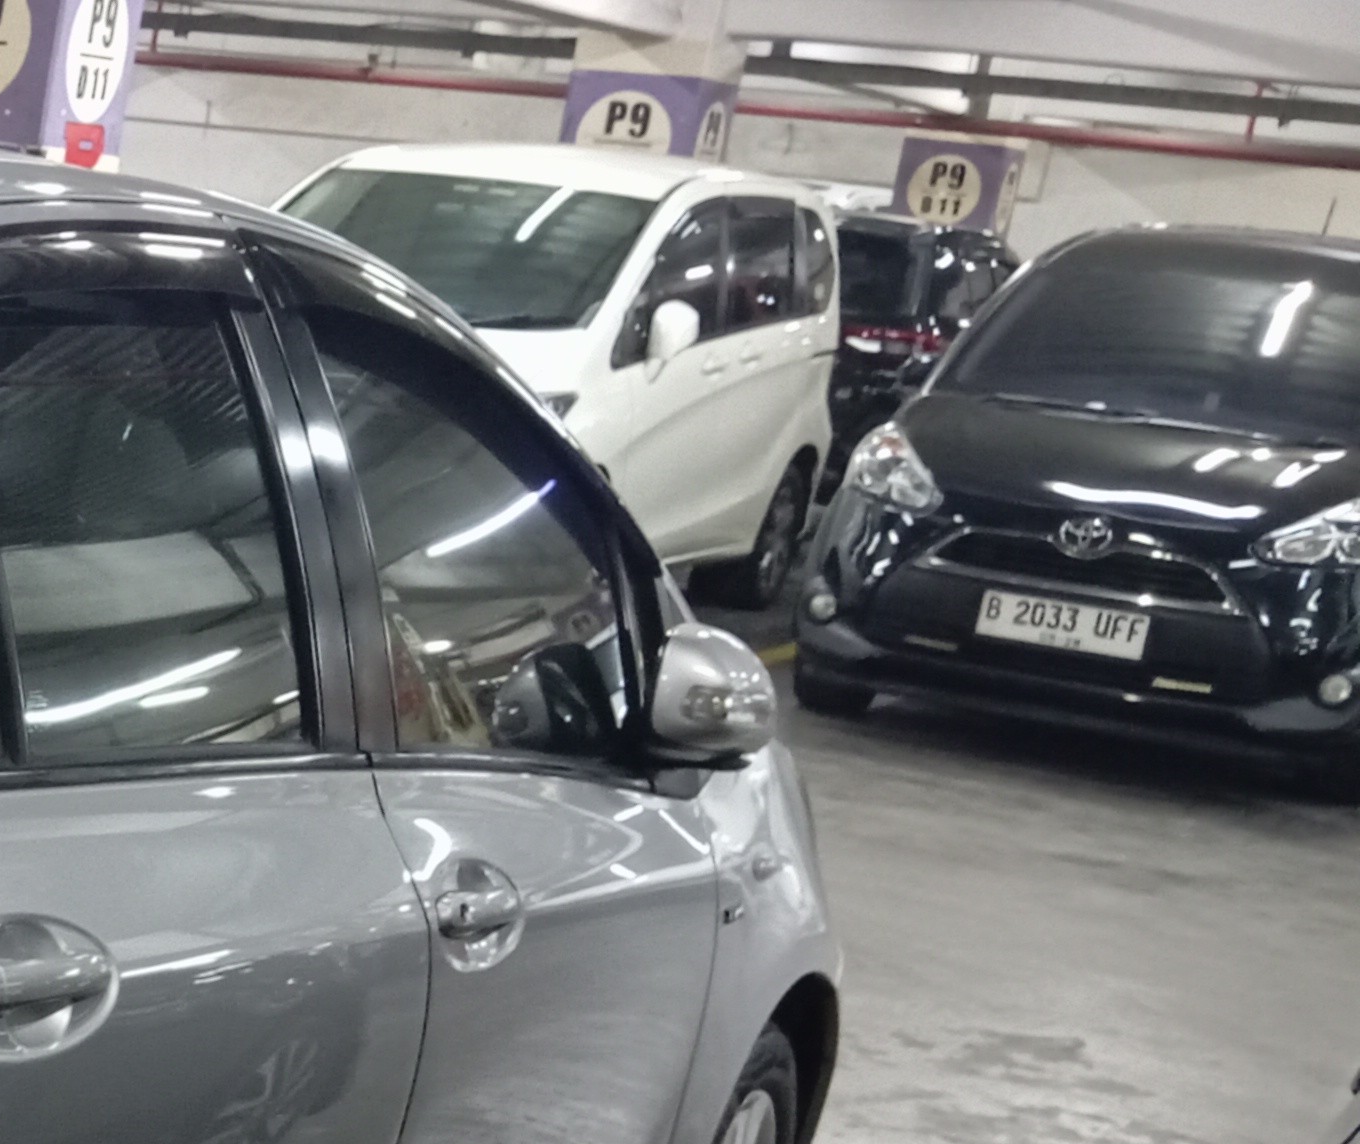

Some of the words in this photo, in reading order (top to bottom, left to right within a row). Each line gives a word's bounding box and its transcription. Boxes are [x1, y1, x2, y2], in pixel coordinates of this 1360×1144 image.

[88, 0, 118, 48] P9
[603, 100, 652, 139] P9
[929, 161, 966, 191] P9
[985, 595, 1002, 621] B
[1012, 601, 1080, 632] 2033
[1093, 611, 1145, 643] UFF
